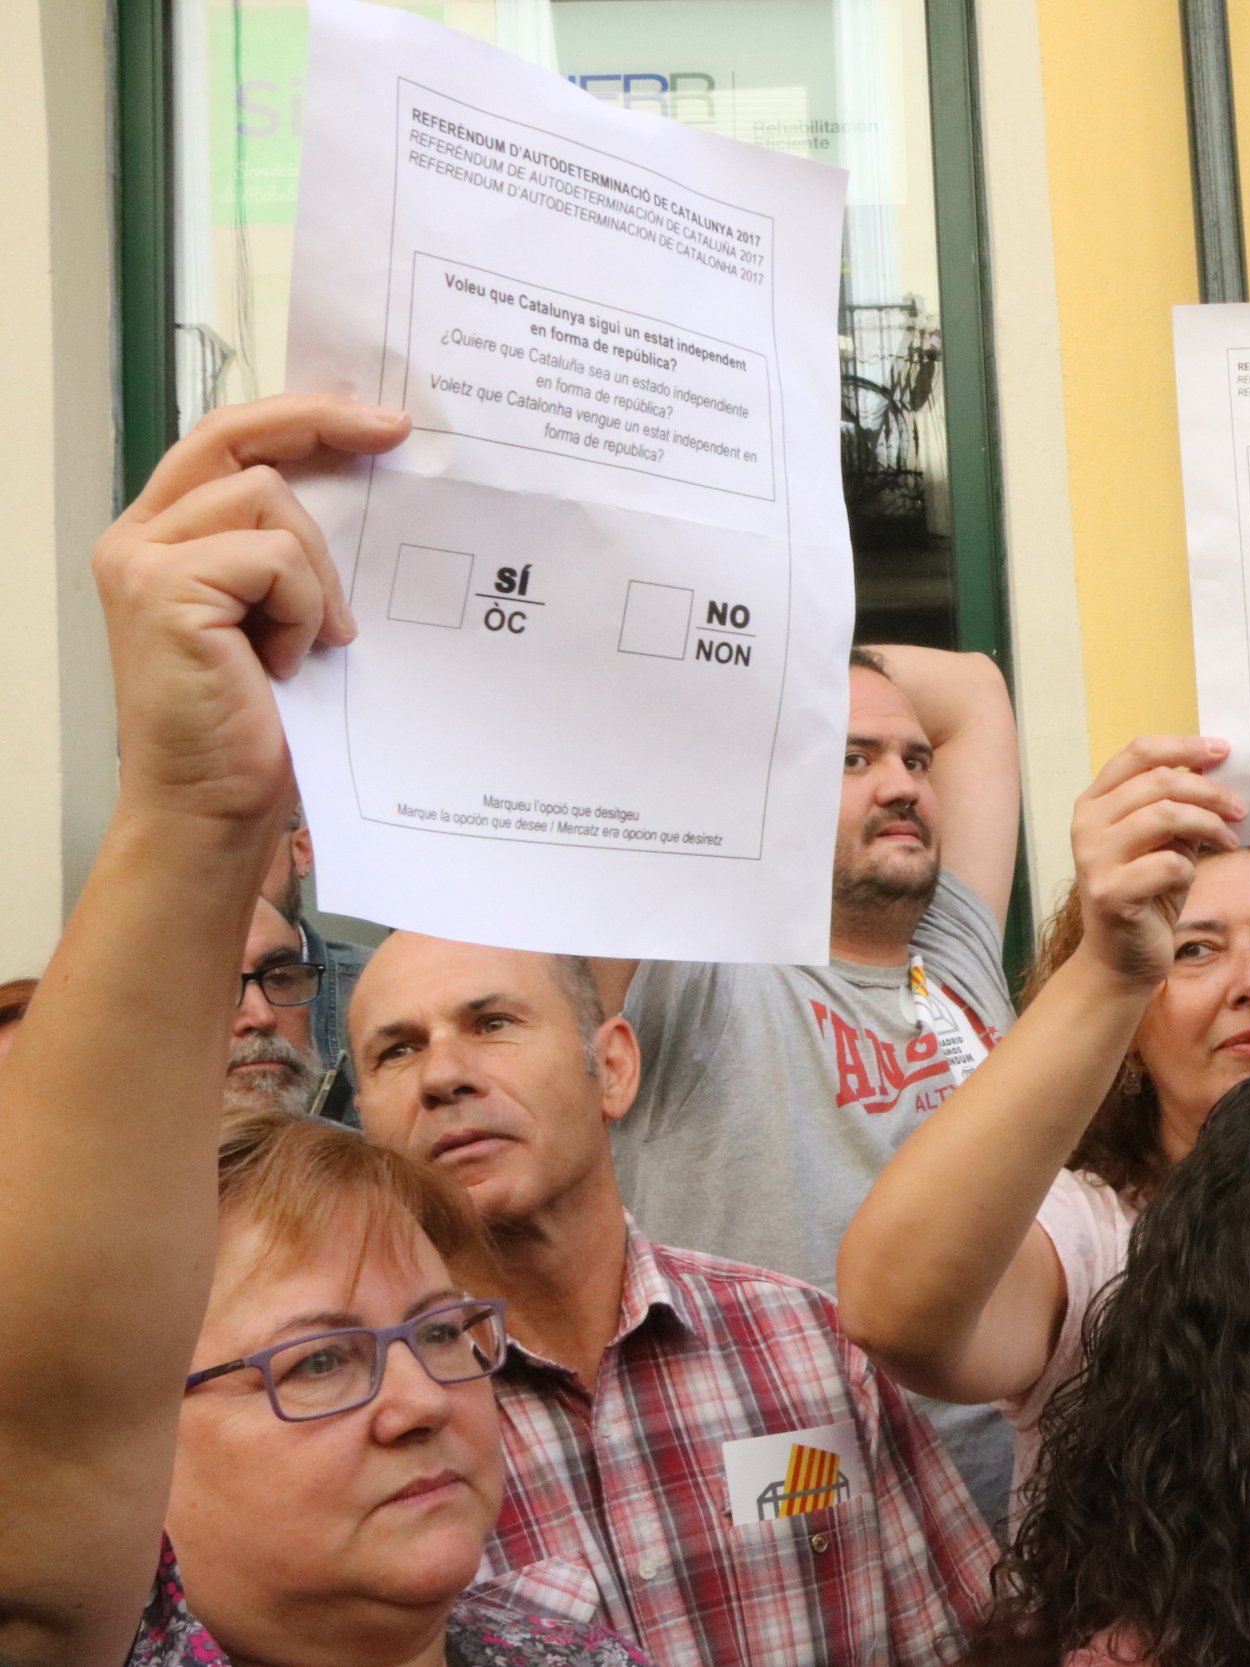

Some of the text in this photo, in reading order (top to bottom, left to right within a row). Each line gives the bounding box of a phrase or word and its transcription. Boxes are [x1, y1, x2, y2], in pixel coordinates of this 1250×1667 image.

[753, 119, 879, 135] Rehabilitación
[408, 128, 763, 266] REFERÉNDUM DE AUTODETERMINACIÓN DE CATALUÑA 2017
[412, 107, 760, 246] REFERÈNDUM D'AUTODETERMINACIÓ DE CATALUNYA 2017
[408, 149, 764, 285] REFERENDUM D'AUTODETERMINACION DE CATALONHA 2017
[444, 272, 746, 372] Voleu que Catalunya sigui un estat independent
[530, 323, 677, 371] en forma de república?
[440, 328, 748, 419] ¿Quiere que Cataluña sea un estado independiente
[535, 375, 673, 419] en forma de república?
[430, 374, 757, 462] Voletz que Catalonha vengue un estat independent en
[544, 423, 664, 462] forma de republica?
[494, 564, 533, 597] SÍ
[483, 602, 527, 635] ÒC
[706, 600, 751, 631] NO
[695, 638, 752, 667] NON
[397, 802, 437, 821] Marque
[440, 809, 450, 822] la
[491, 817, 511, 830] que
[514, 817, 547, 832] desee
[556, 820, 599, 836] Mercatz
[601, 826, 620, 838] era
[622, 827, 657, 841] opcion
[659, 831, 679, 844] que
[681, 831, 723, 846] desiretz
[483, 794, 639, 822] Marqueu l'opció que desitgeu
[945, 1053, 975, 1066] NDUM
[914, 1083, 957, 1114] ALT
